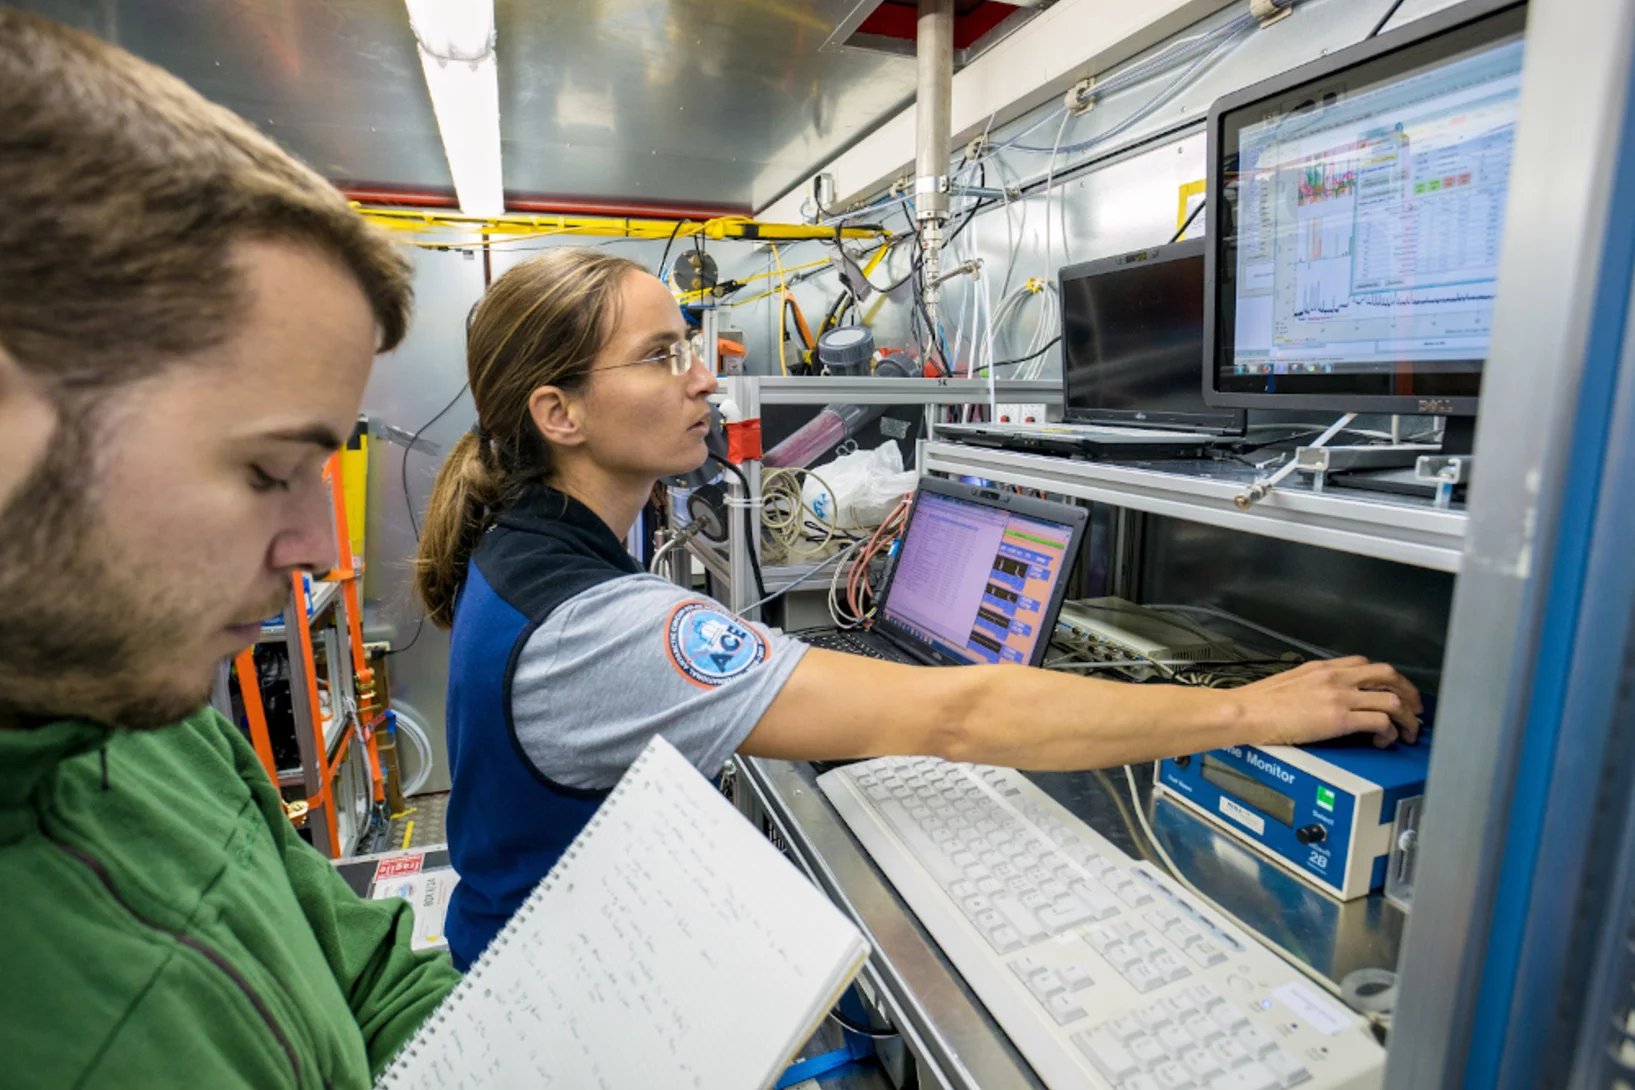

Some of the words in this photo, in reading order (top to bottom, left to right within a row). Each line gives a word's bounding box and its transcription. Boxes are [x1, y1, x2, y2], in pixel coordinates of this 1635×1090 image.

[1418, 399, 1453, 413] DELL
[708, 625, 747, 674] ACE
[1246, 750, 1296, 785] Monitor
[1308, 850, 1328, 869] 2B
